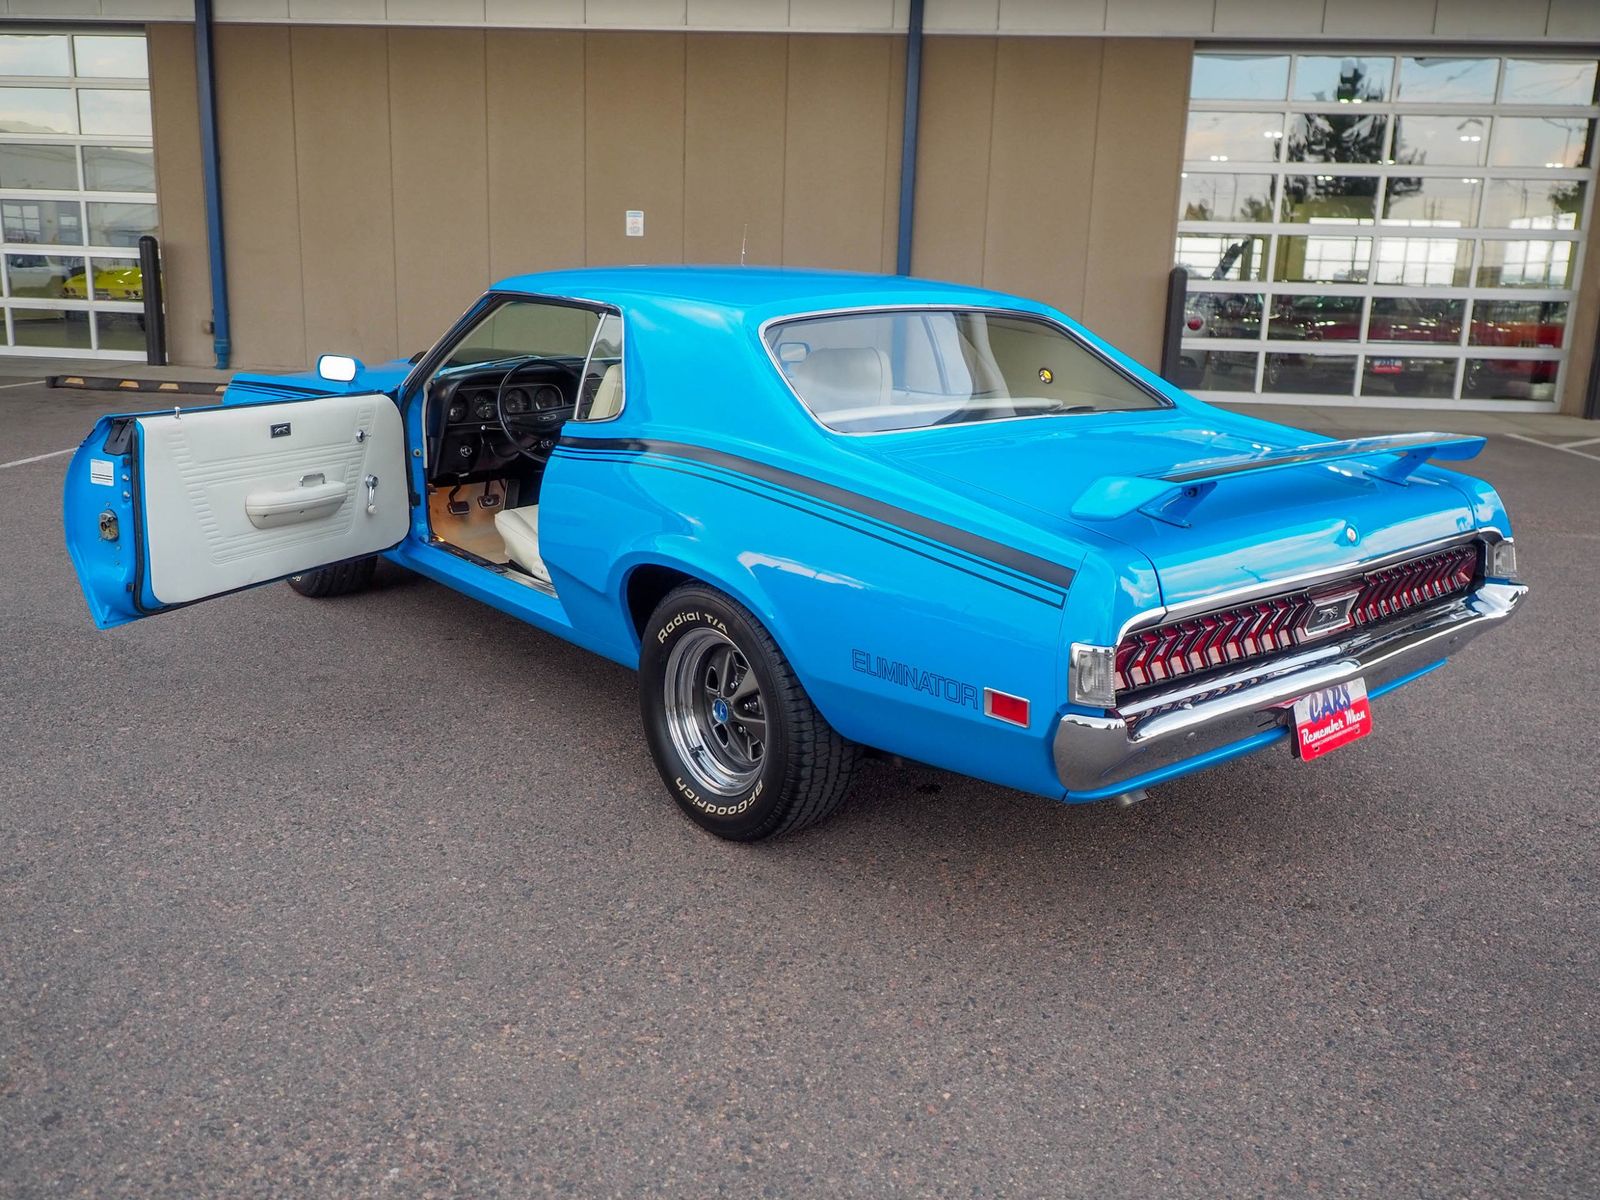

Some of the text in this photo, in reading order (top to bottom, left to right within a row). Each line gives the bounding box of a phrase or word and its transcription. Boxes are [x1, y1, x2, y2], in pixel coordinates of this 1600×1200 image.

[657, 611, 701, 644] Radial
[852, 648, 978, 710] ELIMINATOR
[1309, 683, 1351, 724] CARS
[1301, 718, 1344, 746] Remember
[1344, 708, 1366, 726] When
[675, 777, 764, 816] BFGoodrich
